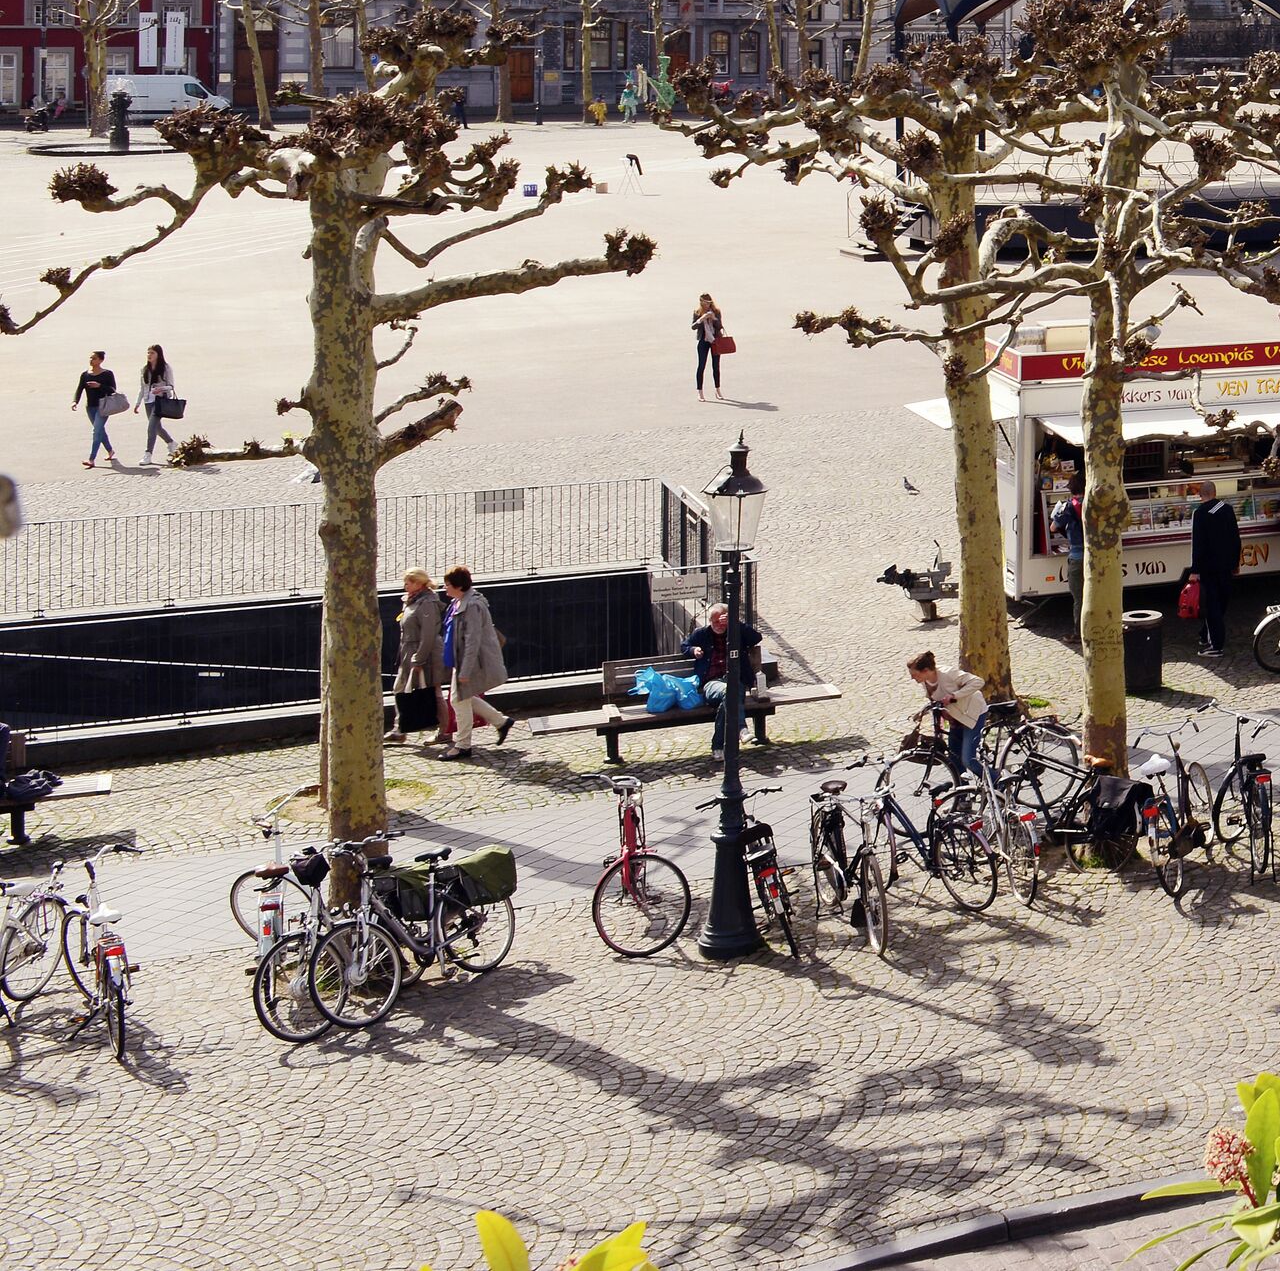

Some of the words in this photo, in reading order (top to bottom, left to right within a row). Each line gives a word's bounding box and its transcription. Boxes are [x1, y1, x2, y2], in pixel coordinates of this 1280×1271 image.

[1120, 389, 1161, 404] kkers
[1216, 379, 1249, 399] YEN
[1136, 560, 1166, 575] van
[1240, 540, 1269, 567] EN
